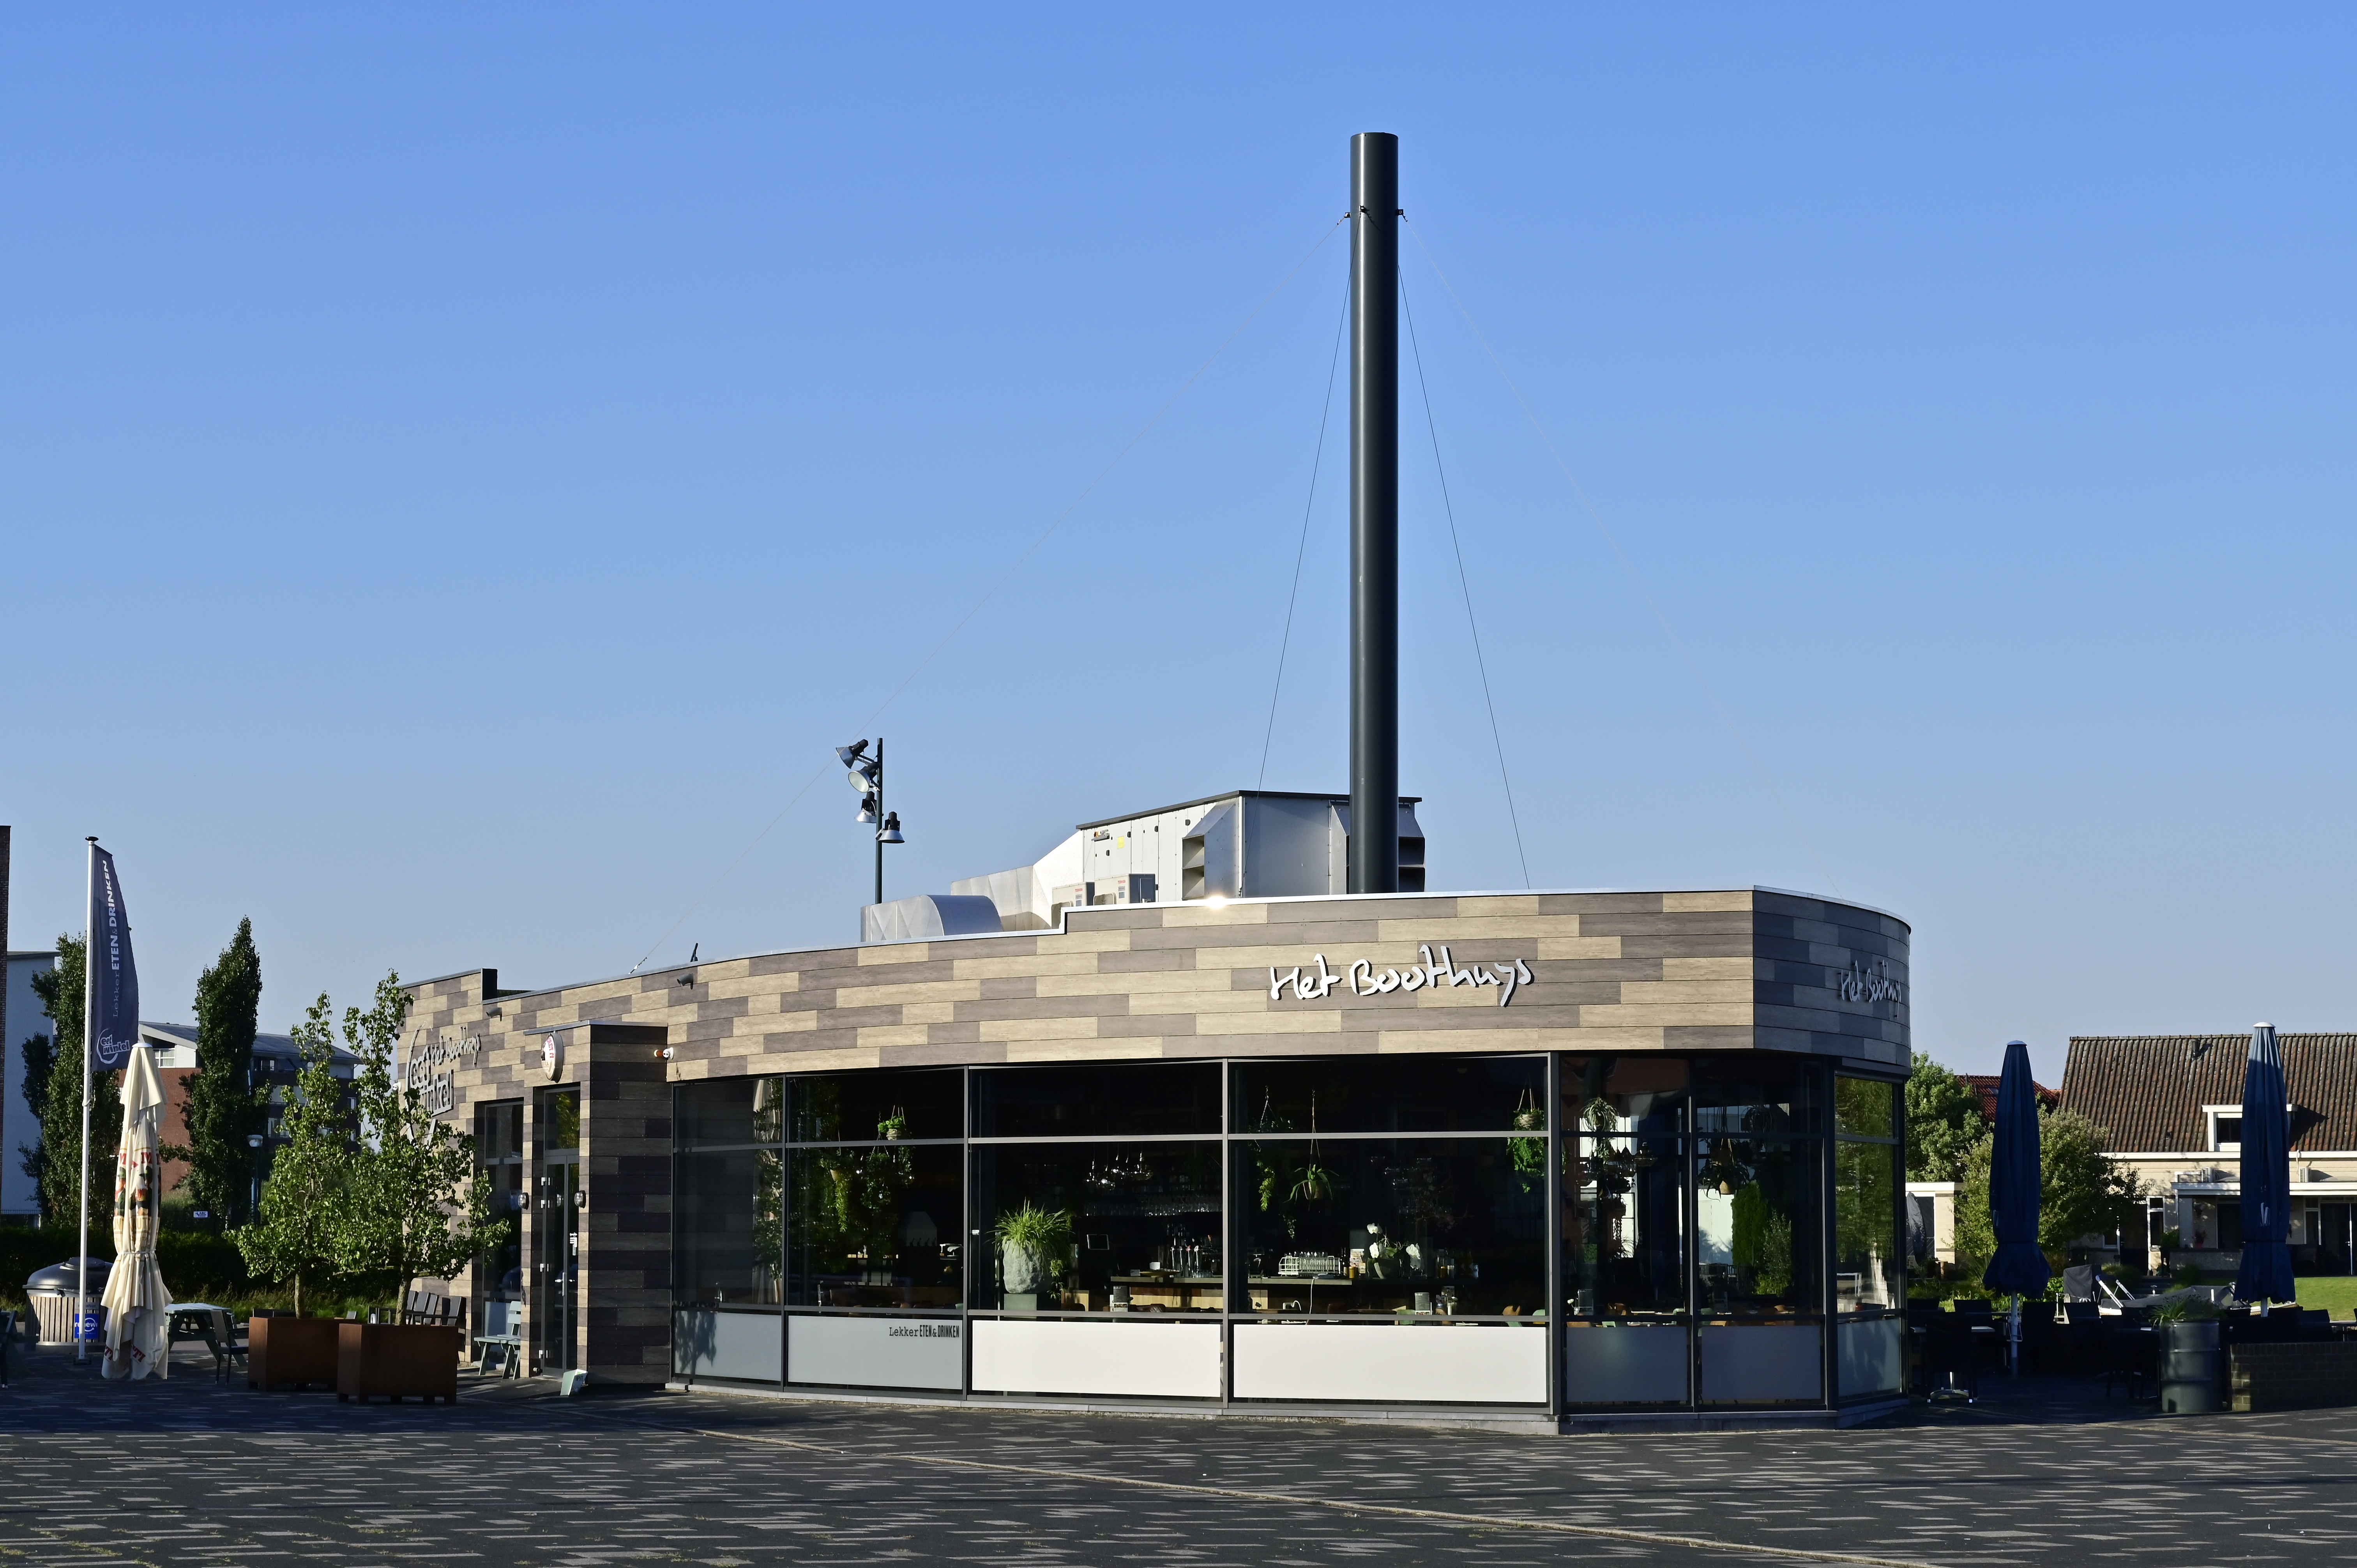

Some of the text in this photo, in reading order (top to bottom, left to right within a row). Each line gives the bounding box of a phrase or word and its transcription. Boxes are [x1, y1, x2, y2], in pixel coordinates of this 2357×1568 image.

[1270, 944, 1535, 1007] Het Boothuys
[1841, 960, 1863, 1002] Het
[419, 1068, 454, 1118] inkel
